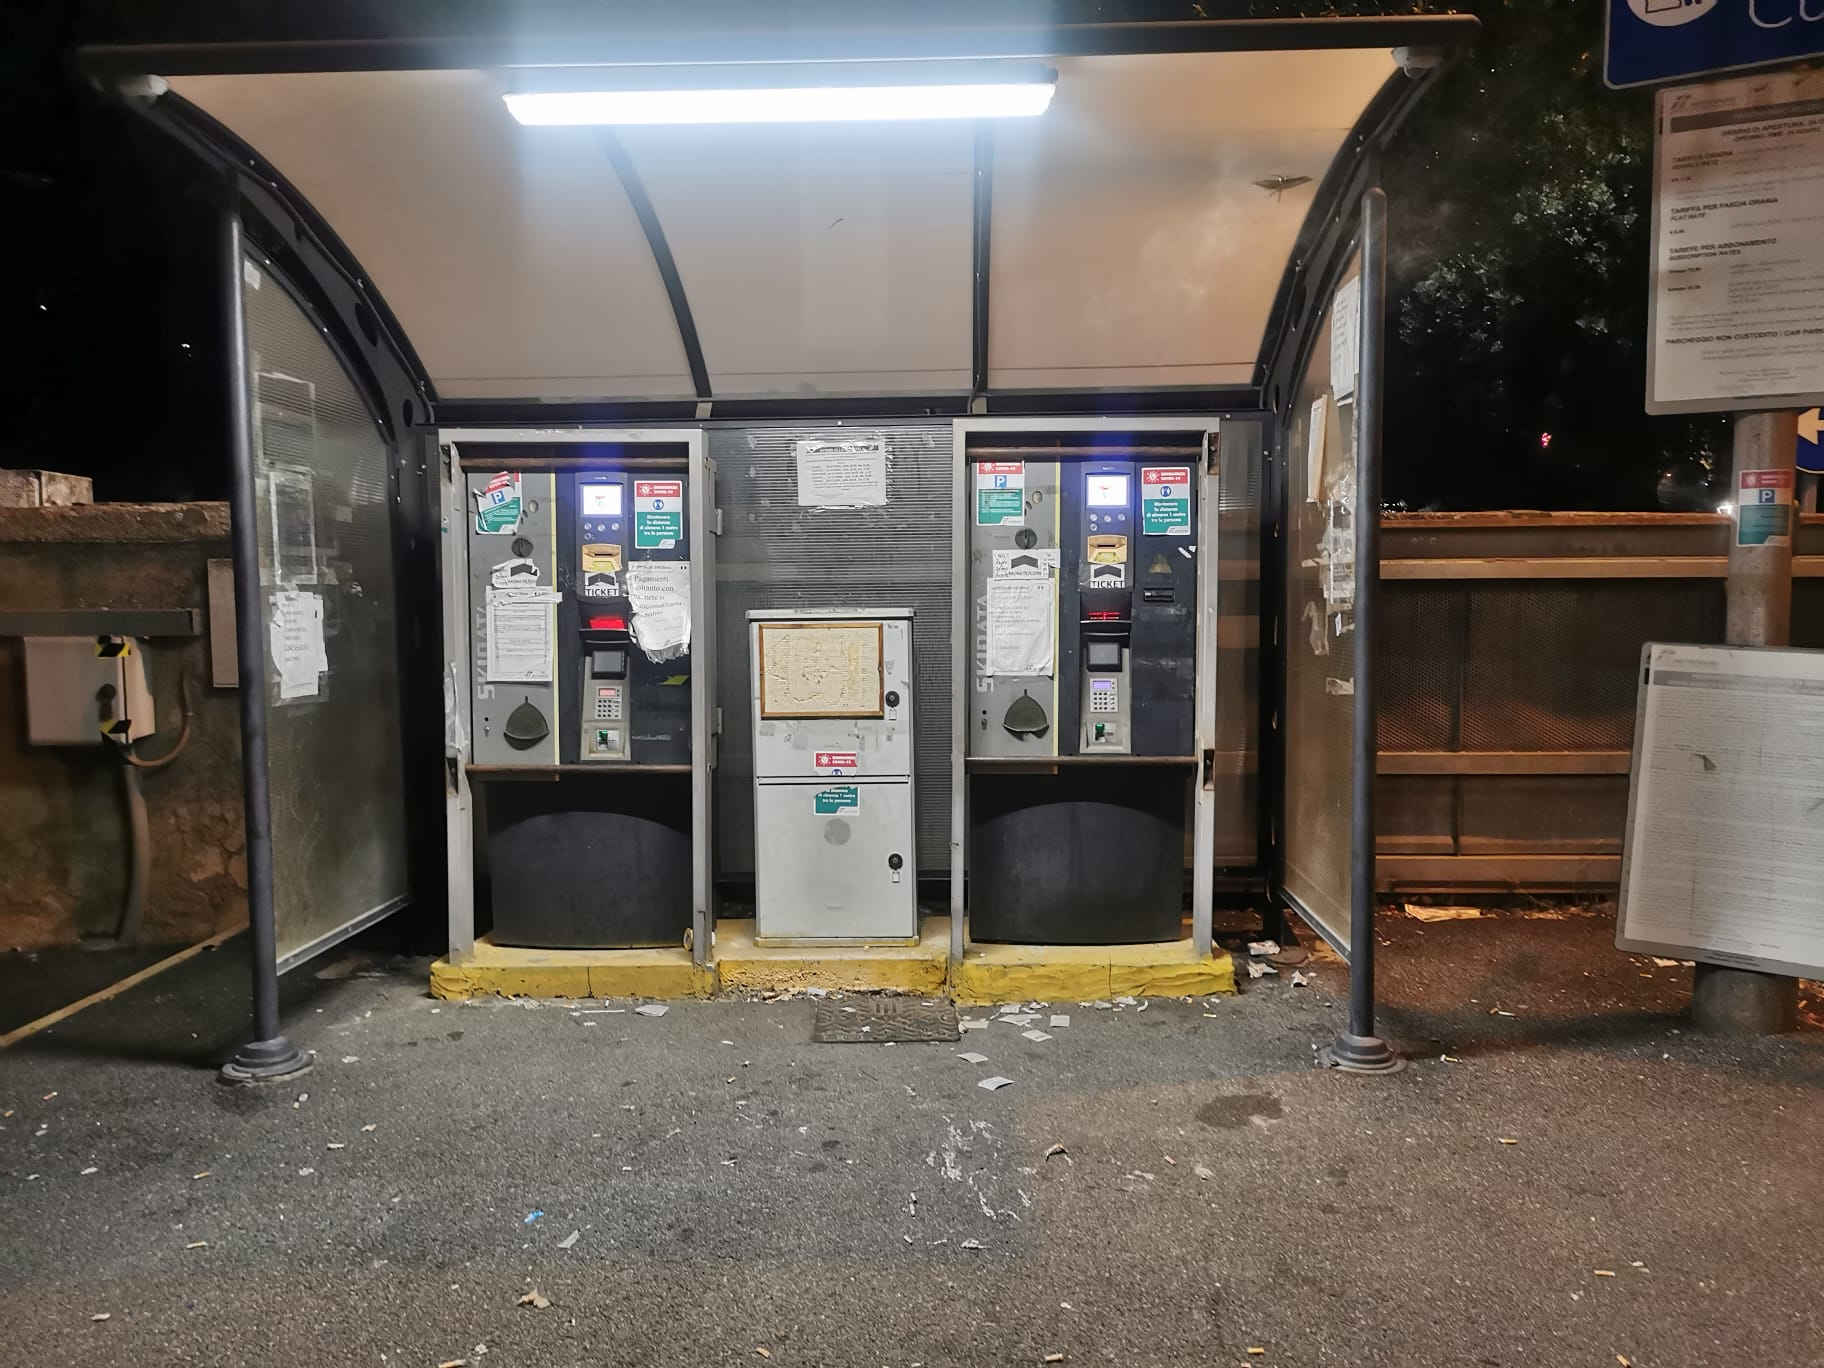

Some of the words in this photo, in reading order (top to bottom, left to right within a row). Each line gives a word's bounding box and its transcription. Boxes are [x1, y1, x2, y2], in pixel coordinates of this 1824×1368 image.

[996, 475, 1006, 488] P
[1761, 490, 1773, 503] P
[1091, 580, 1124, 589] TICKET
[586, 588, 618, 597] TICKET
[976, 594, 994, 692] SKIDATA
